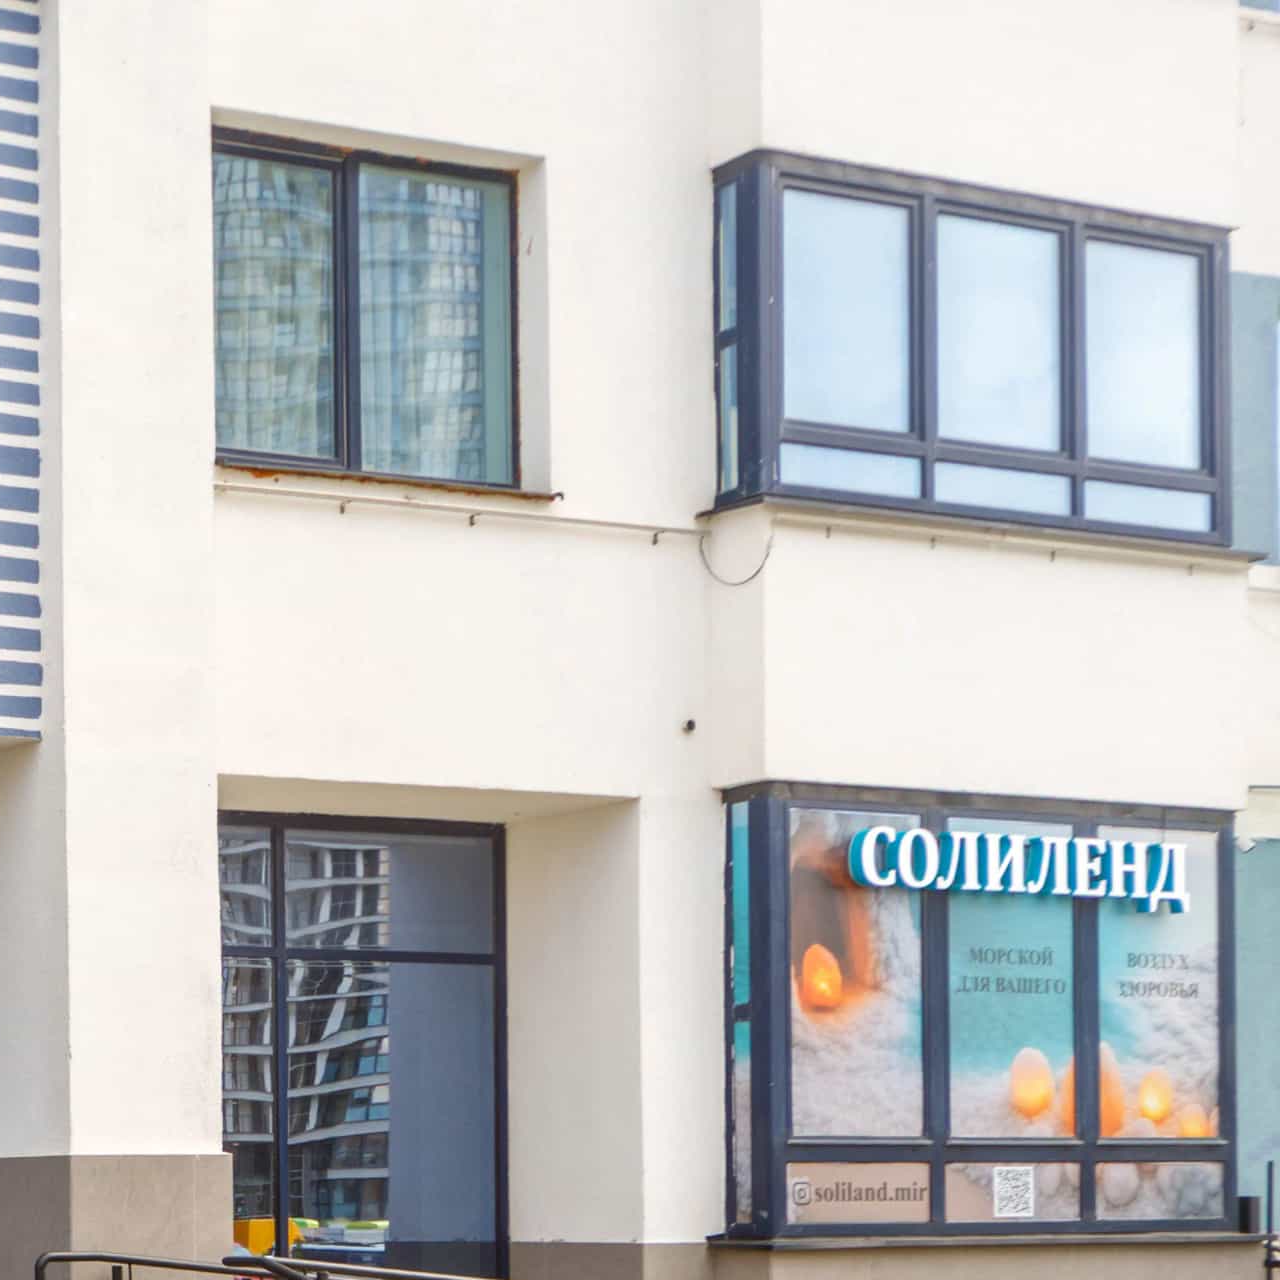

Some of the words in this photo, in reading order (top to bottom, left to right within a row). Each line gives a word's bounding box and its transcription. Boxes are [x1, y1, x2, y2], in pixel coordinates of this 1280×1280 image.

[850, 824, 1191, 914] СОЛИЛЕНД
[968, 946, 1055, 967] МОРСКОЙ
[1126, 952, 1191, 970] ВОЗДУХ
[955, 975, 994, 994] ДЛЯ
[995, 976, 1067, 995] ВАШЕГО
[1118, 980, 1200, 999] ЗДОРОВЬЯ
[814, 1181, 929, 1202] soliland.mir
